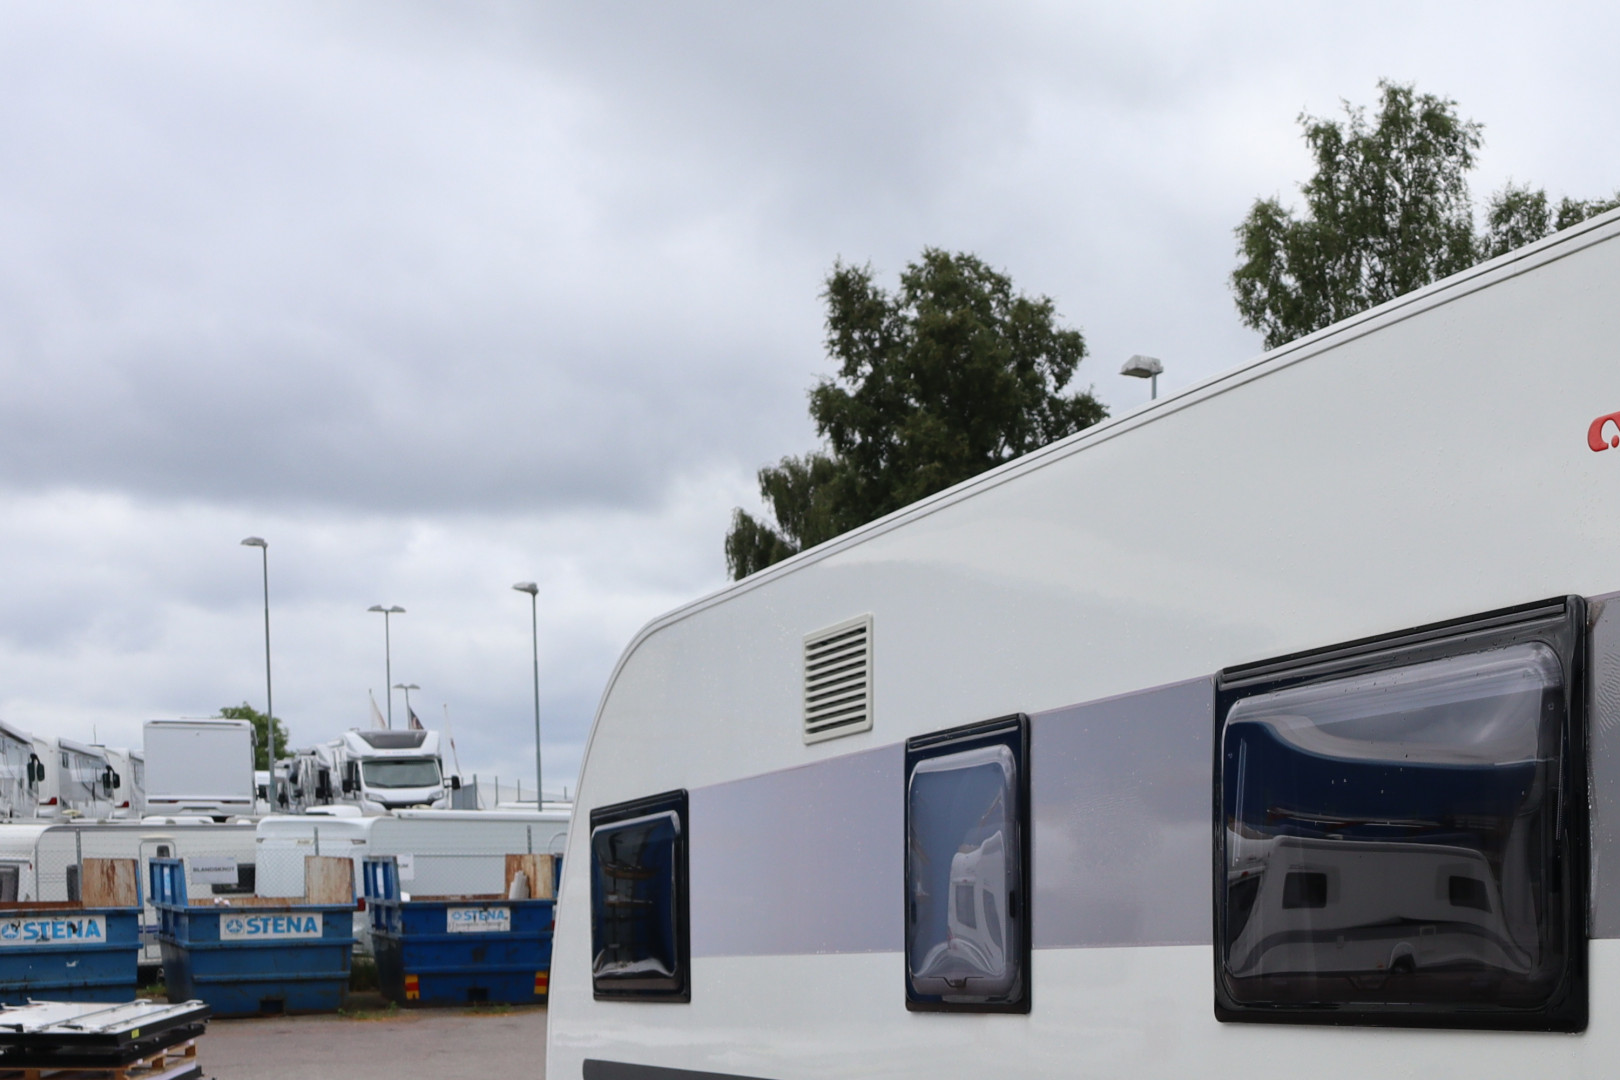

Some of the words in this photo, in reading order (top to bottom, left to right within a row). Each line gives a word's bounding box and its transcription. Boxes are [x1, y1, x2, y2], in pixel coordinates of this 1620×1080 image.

[464, 909, 505, 921] STENA
[23, 919, 101, 940] STENA
[246, 916, 318, 935] STENA
